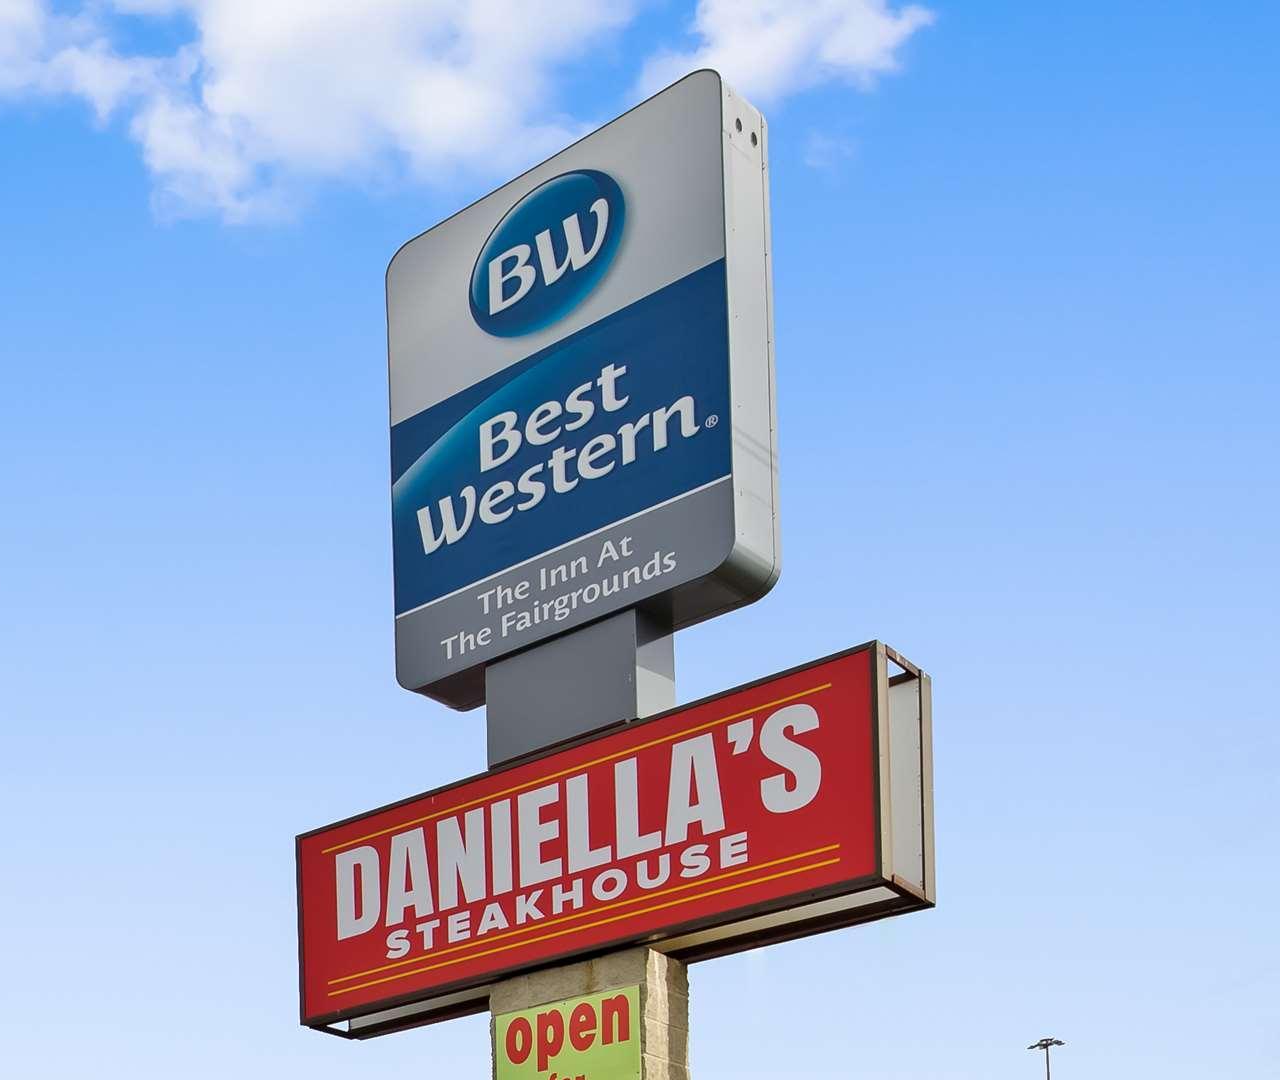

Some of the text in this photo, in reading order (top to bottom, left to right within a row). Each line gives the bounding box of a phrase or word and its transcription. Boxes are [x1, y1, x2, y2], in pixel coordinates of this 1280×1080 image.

[488, 198, 609, 316] BW
[416, 394, 701, 555] Western
[479, 363, 630, 473] Best
[440, 551, 678, 660] The Fairgrounds
[477, 536, 634, 615] The Inn At
[335, 703, 823, 942] DANIELLA'S
[384, 831, 749, 960] STEAKHOUSE
[505, 993, 630, 1073] open
